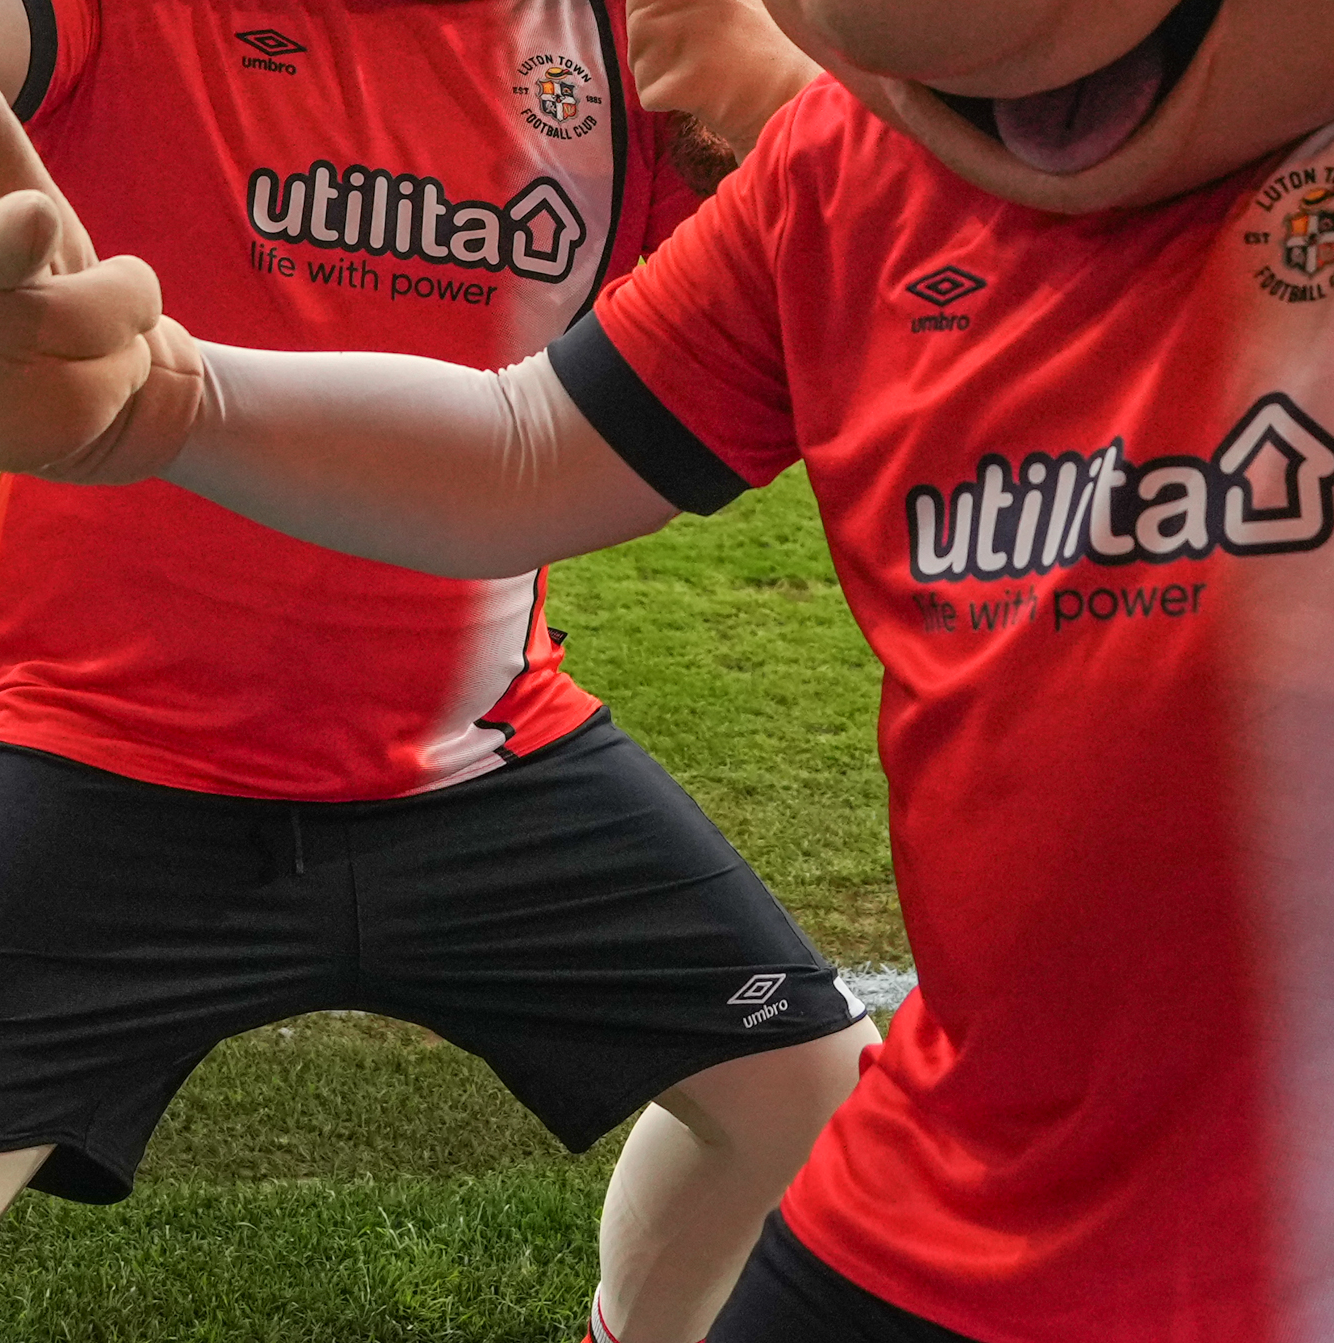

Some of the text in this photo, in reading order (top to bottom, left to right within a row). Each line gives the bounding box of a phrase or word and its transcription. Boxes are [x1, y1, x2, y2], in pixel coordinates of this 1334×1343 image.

[242, 56, 297, 76] umbro
[517, 54, 592, 83] LUTON TOWN
[512, 86, 602, 105] EST 1885
[521, 108, 598, 140] FOOTBALL CLUB
[1256, 168, 1317, 213] LUTON
[250, 164, 502, 267] utilita
[1244, 231, 1270, 245] EST
[250, 241, 498, 306] life with power
[1254, 265, 1327, 303] FOOTBALL
[911, 311, 970, 334] umbro
[914, 444, 1210, 577] utilita
[1053, 582, 1207, 633] power
[742, 999, 788, 1029] umbro
